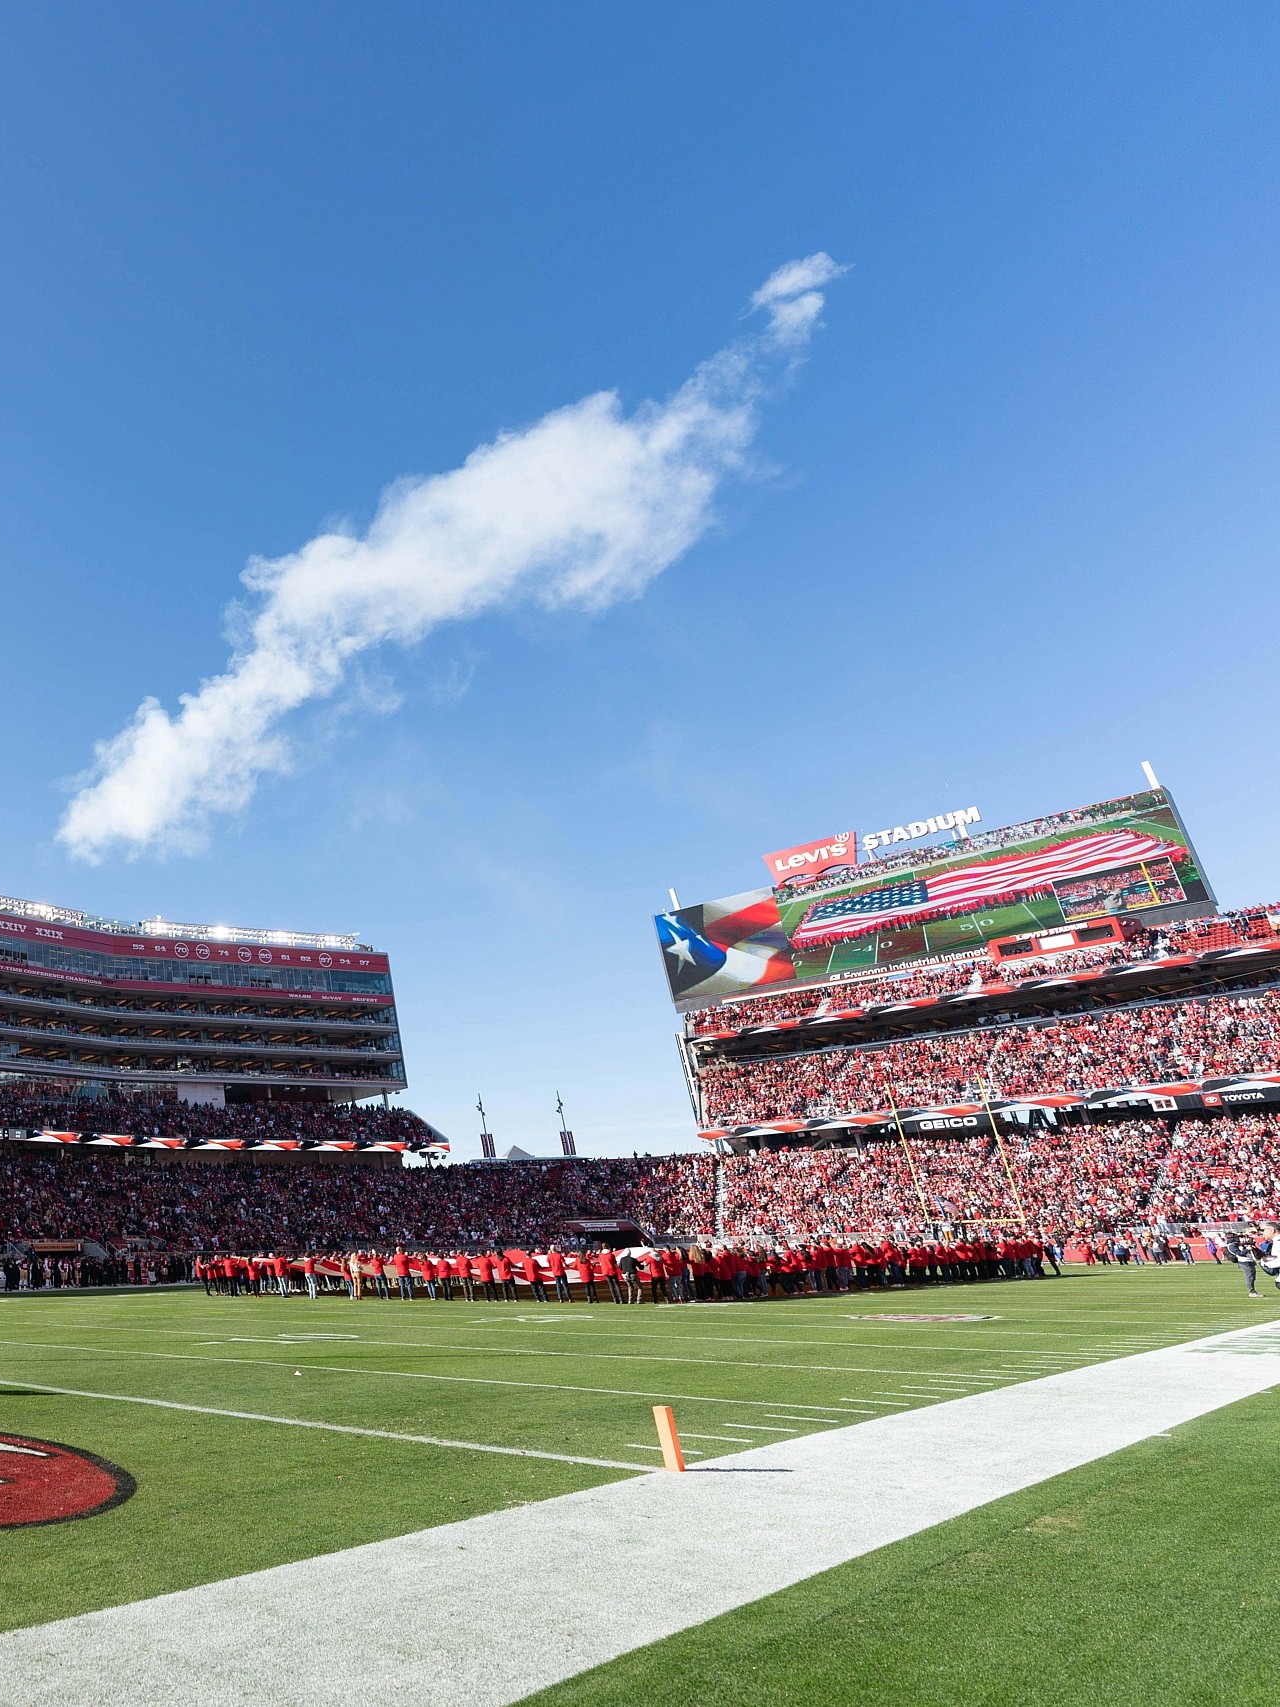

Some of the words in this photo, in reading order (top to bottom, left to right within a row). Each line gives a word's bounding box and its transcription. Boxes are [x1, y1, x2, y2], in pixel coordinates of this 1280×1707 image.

[862, 806, 983, 851] STADIUM
[35, 927, 64, 940] XXIX
[843, 966, 888, 979] Foxconn
[889, 954, 940, 971] Industrial
[23, 969, 65, 979] CONFERENCE
[65, 975, 102, 985] CHAMPIONS
[1222, 1093, 1265, 1102] TOYOTA
[920, 1117, 978, 1130] GEICO
